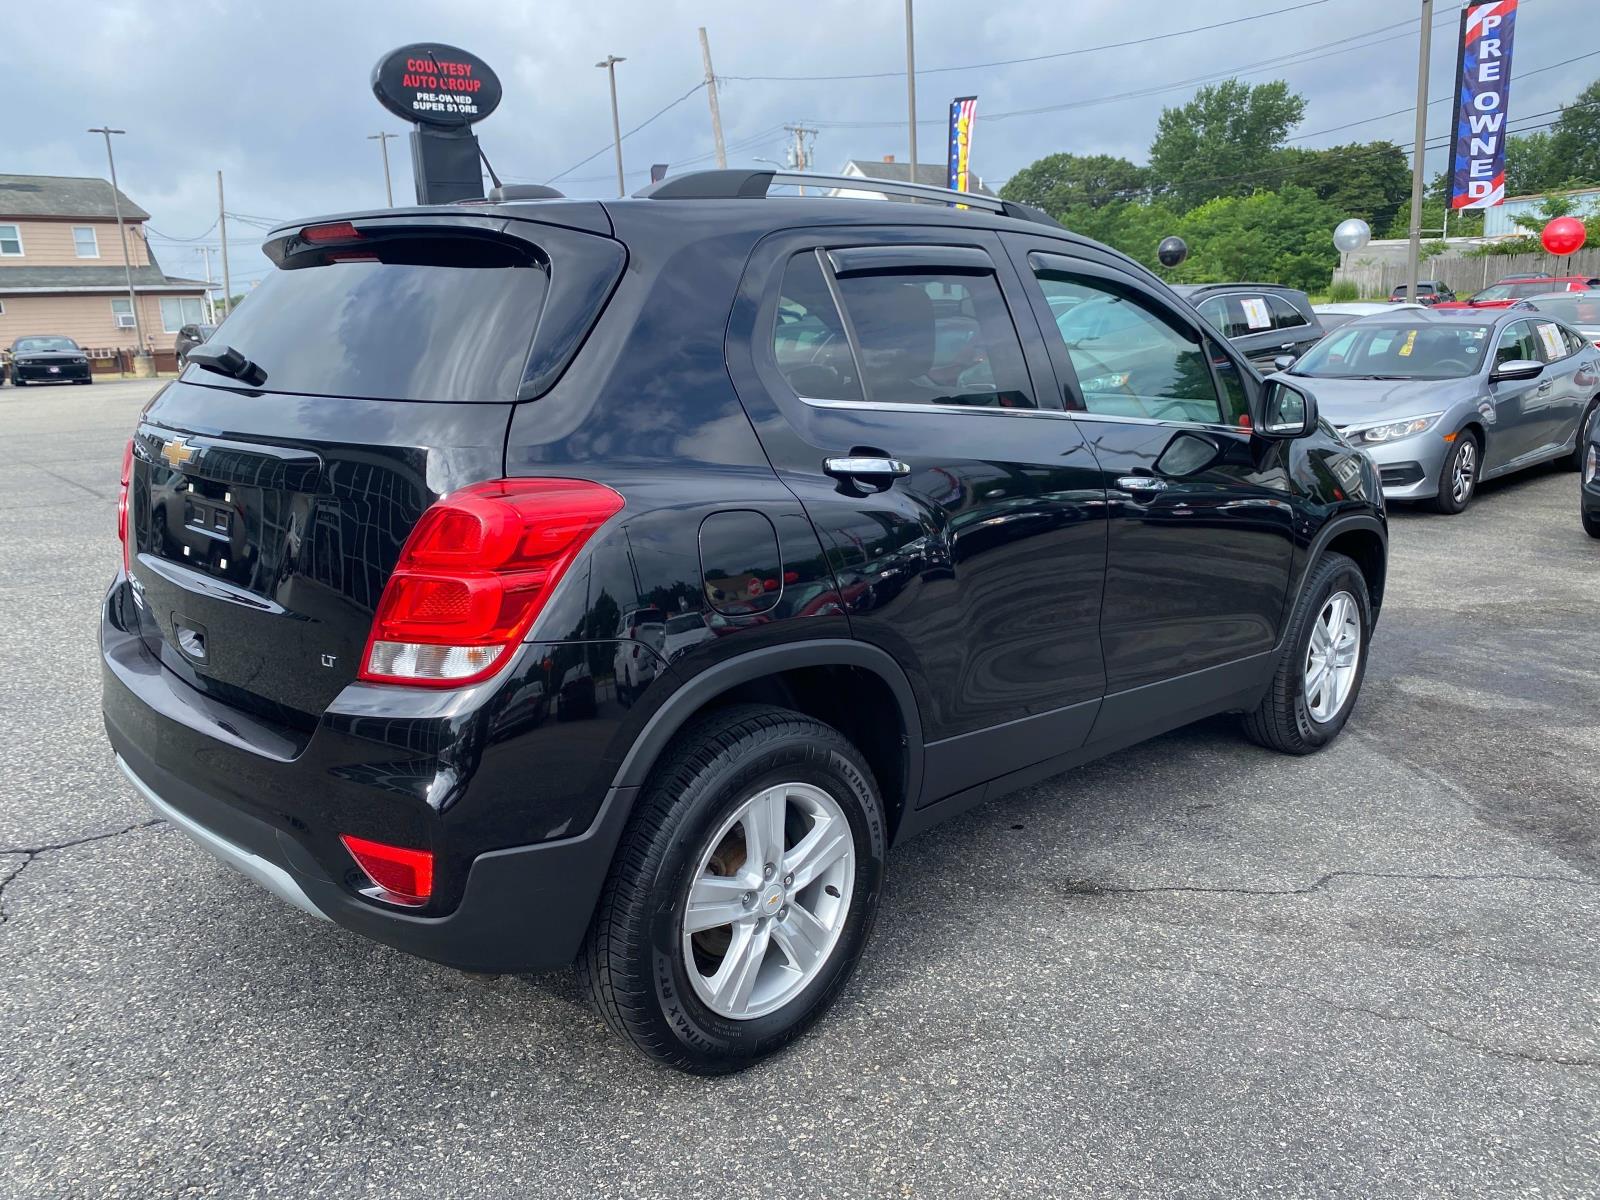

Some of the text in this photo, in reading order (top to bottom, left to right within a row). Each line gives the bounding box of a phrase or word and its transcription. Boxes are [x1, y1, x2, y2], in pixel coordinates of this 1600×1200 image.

[404, 75, 436, 88] AUTO
[413, 102, 444, 111] SUPER
[1468, 15, 1504, 199] PRE OWNED
[321, 654, 336, 667] LT
[669, 1006, 718, 1051] LTIMAX
